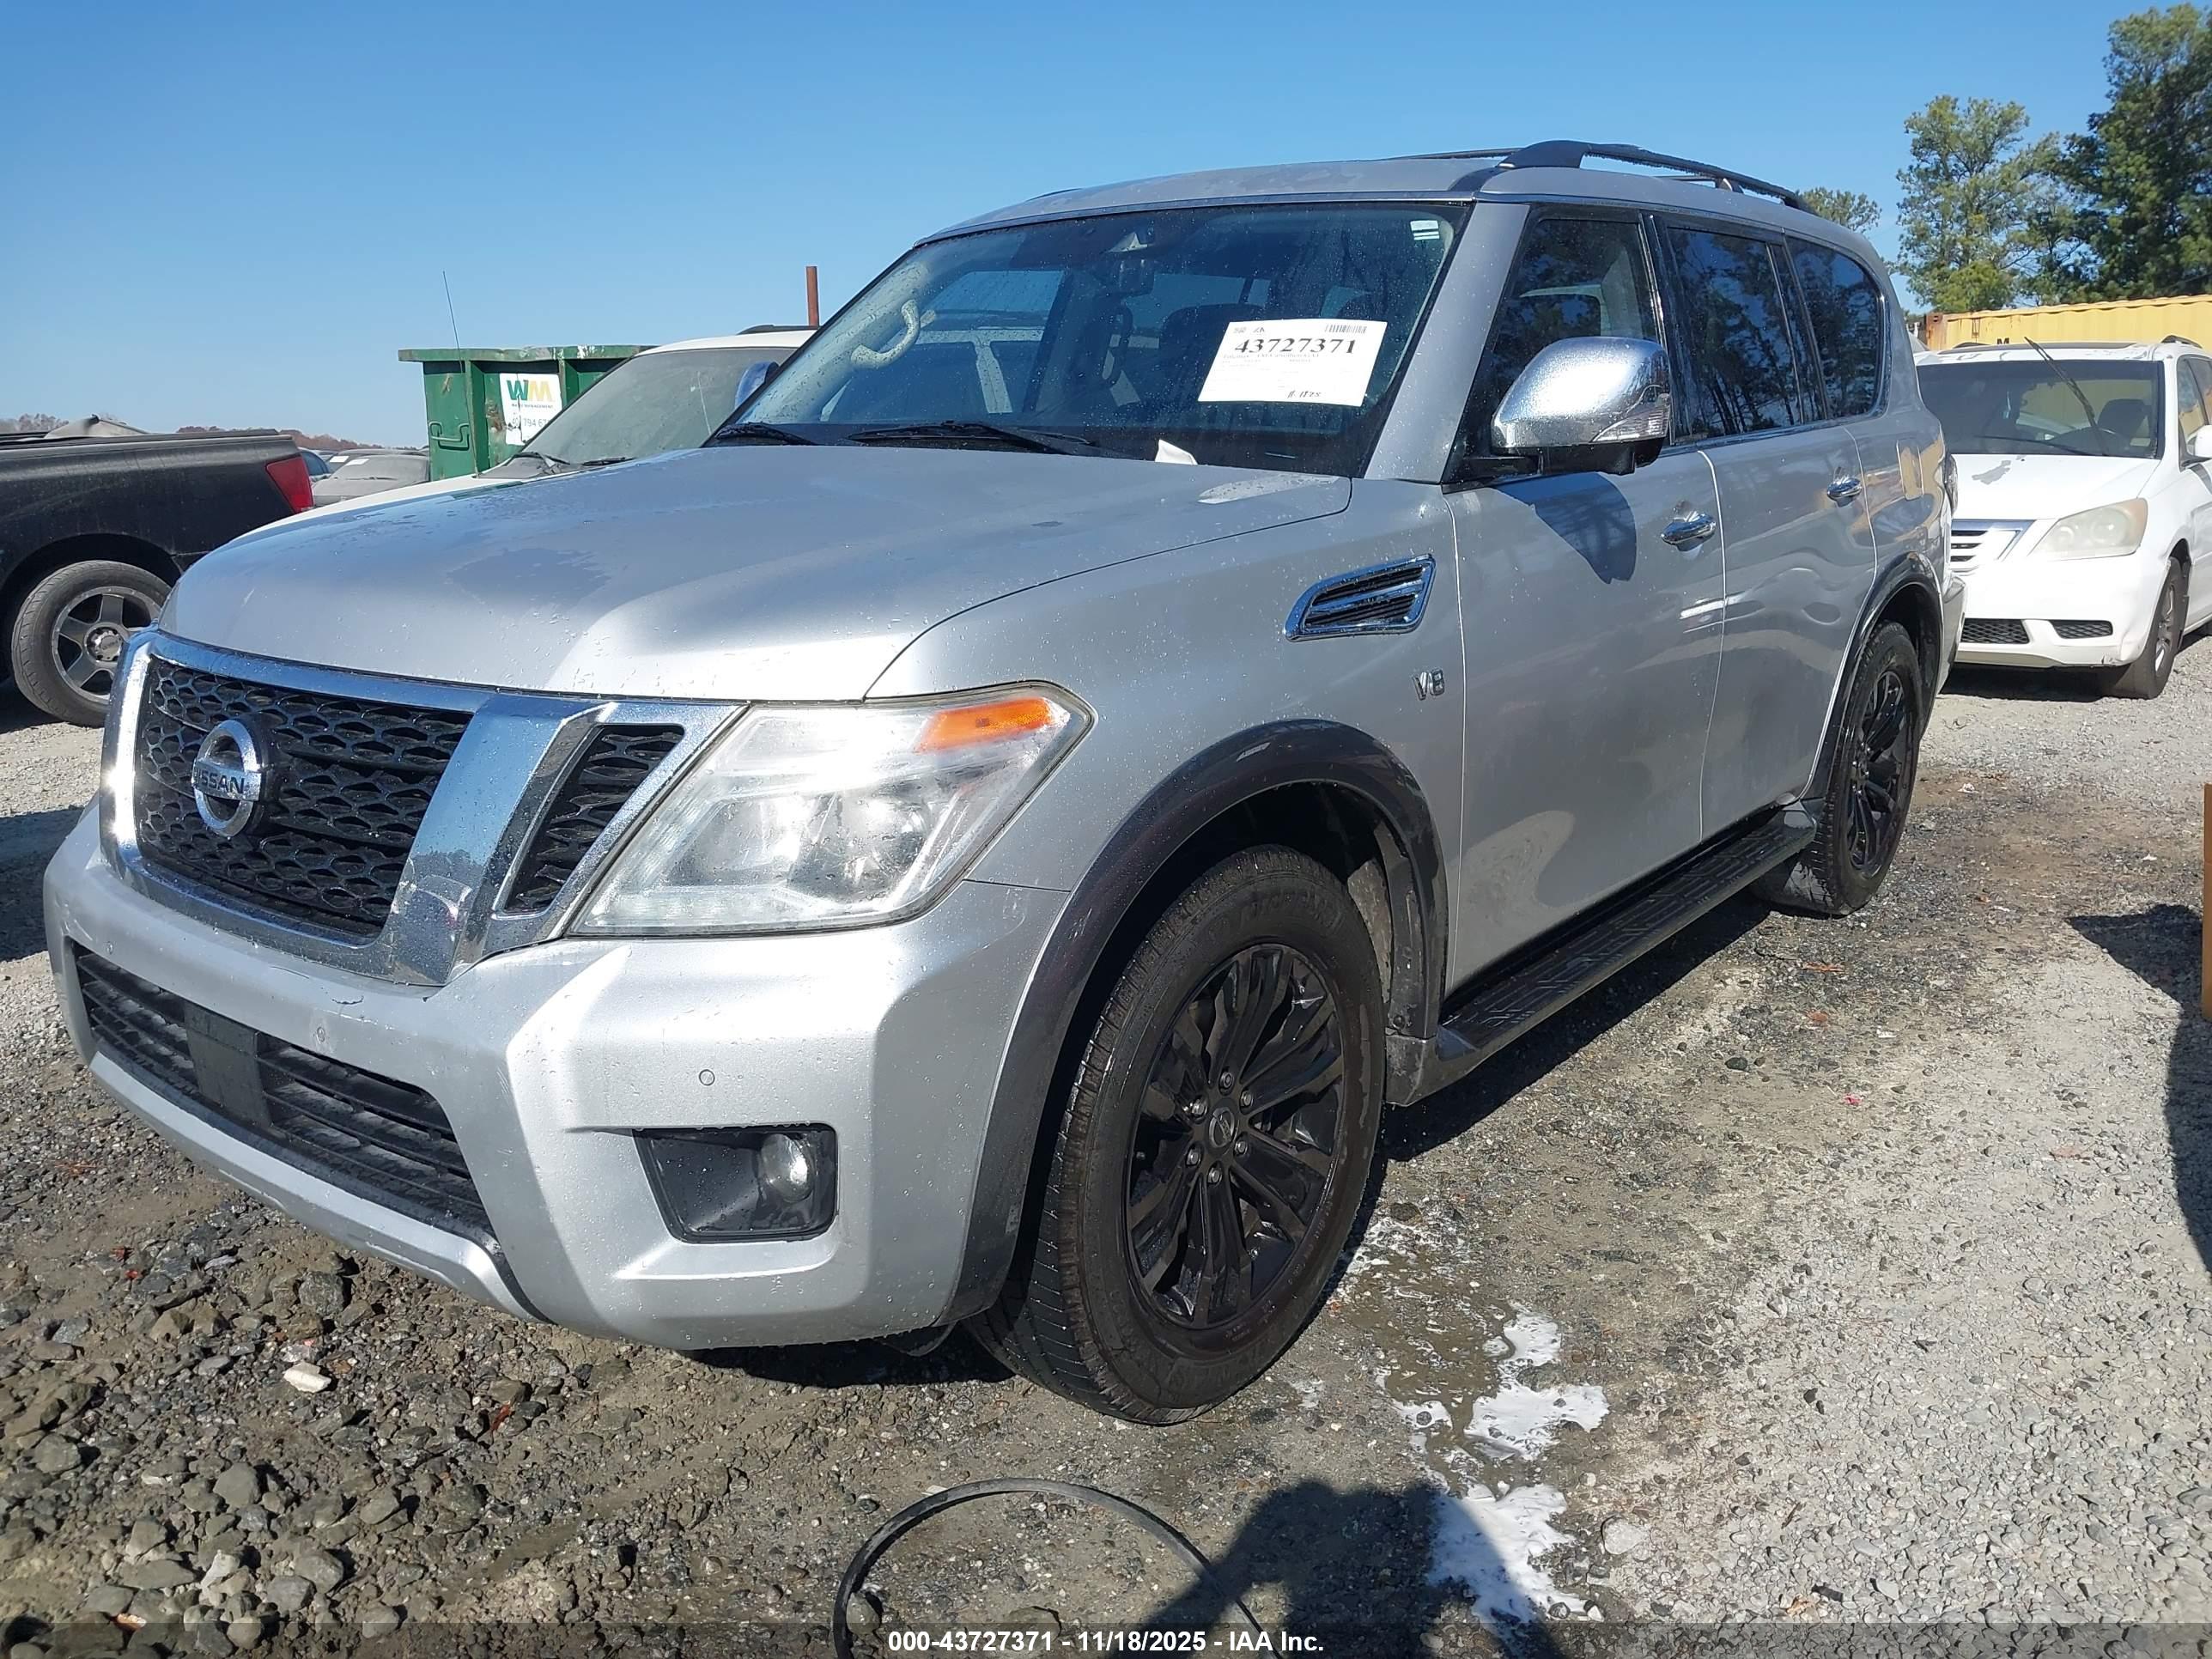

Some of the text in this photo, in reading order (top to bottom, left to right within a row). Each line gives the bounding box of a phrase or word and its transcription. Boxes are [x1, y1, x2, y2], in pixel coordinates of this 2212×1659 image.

[1235, 337, 1357, 354] 43727371
[507, 380, 553, 402] WM
[193, 765, 246, 793] NISSAN
